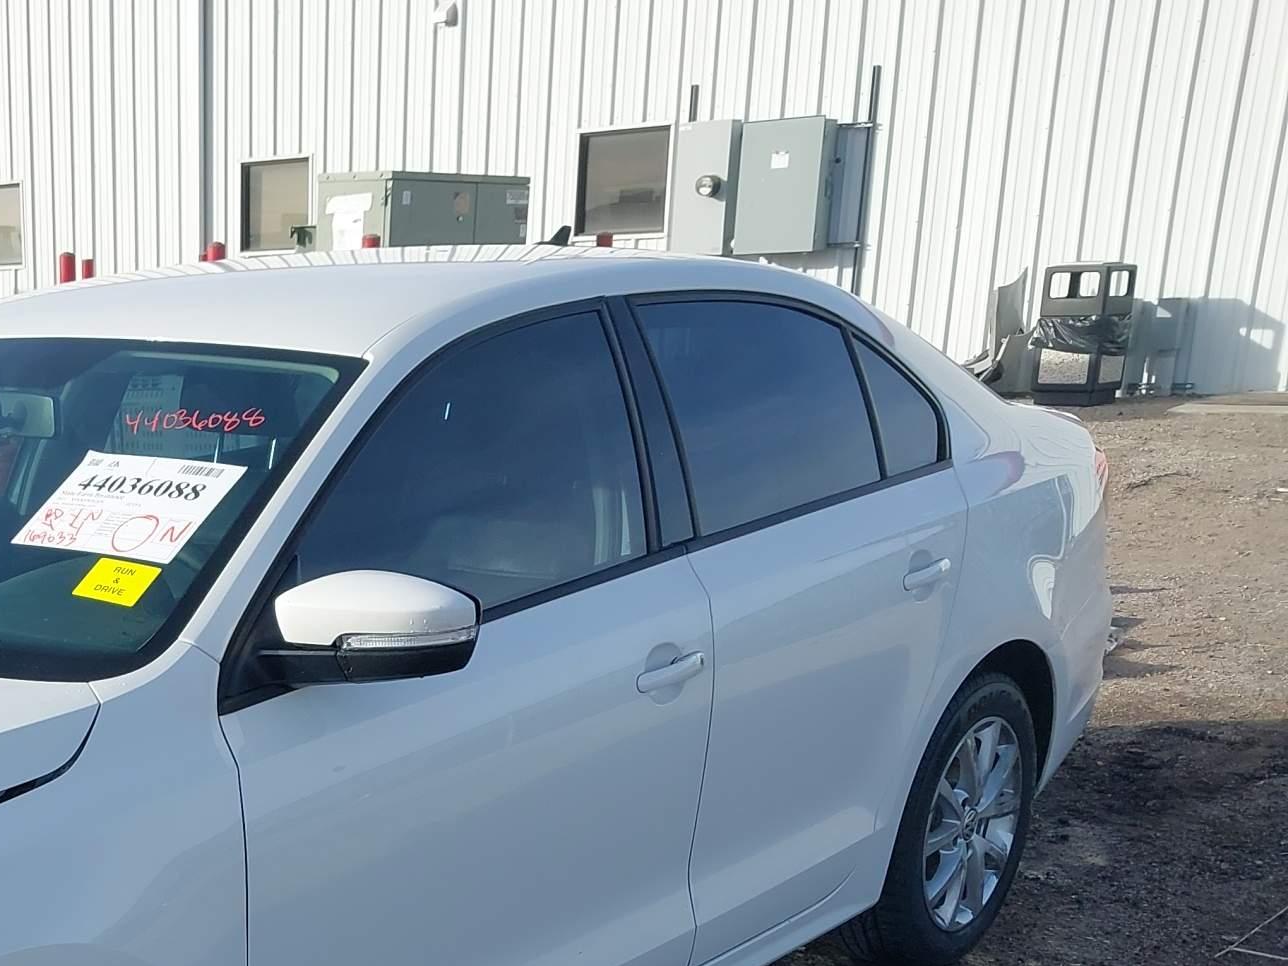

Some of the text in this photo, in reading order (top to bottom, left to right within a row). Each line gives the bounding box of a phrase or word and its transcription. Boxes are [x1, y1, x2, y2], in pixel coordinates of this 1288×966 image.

[125, 407, 265, 435] 44036088
[77, 474, 207, 501] 44036088
[113, 566, 137, 576] RUN
[93, 583, 126, 597] DRIVE
